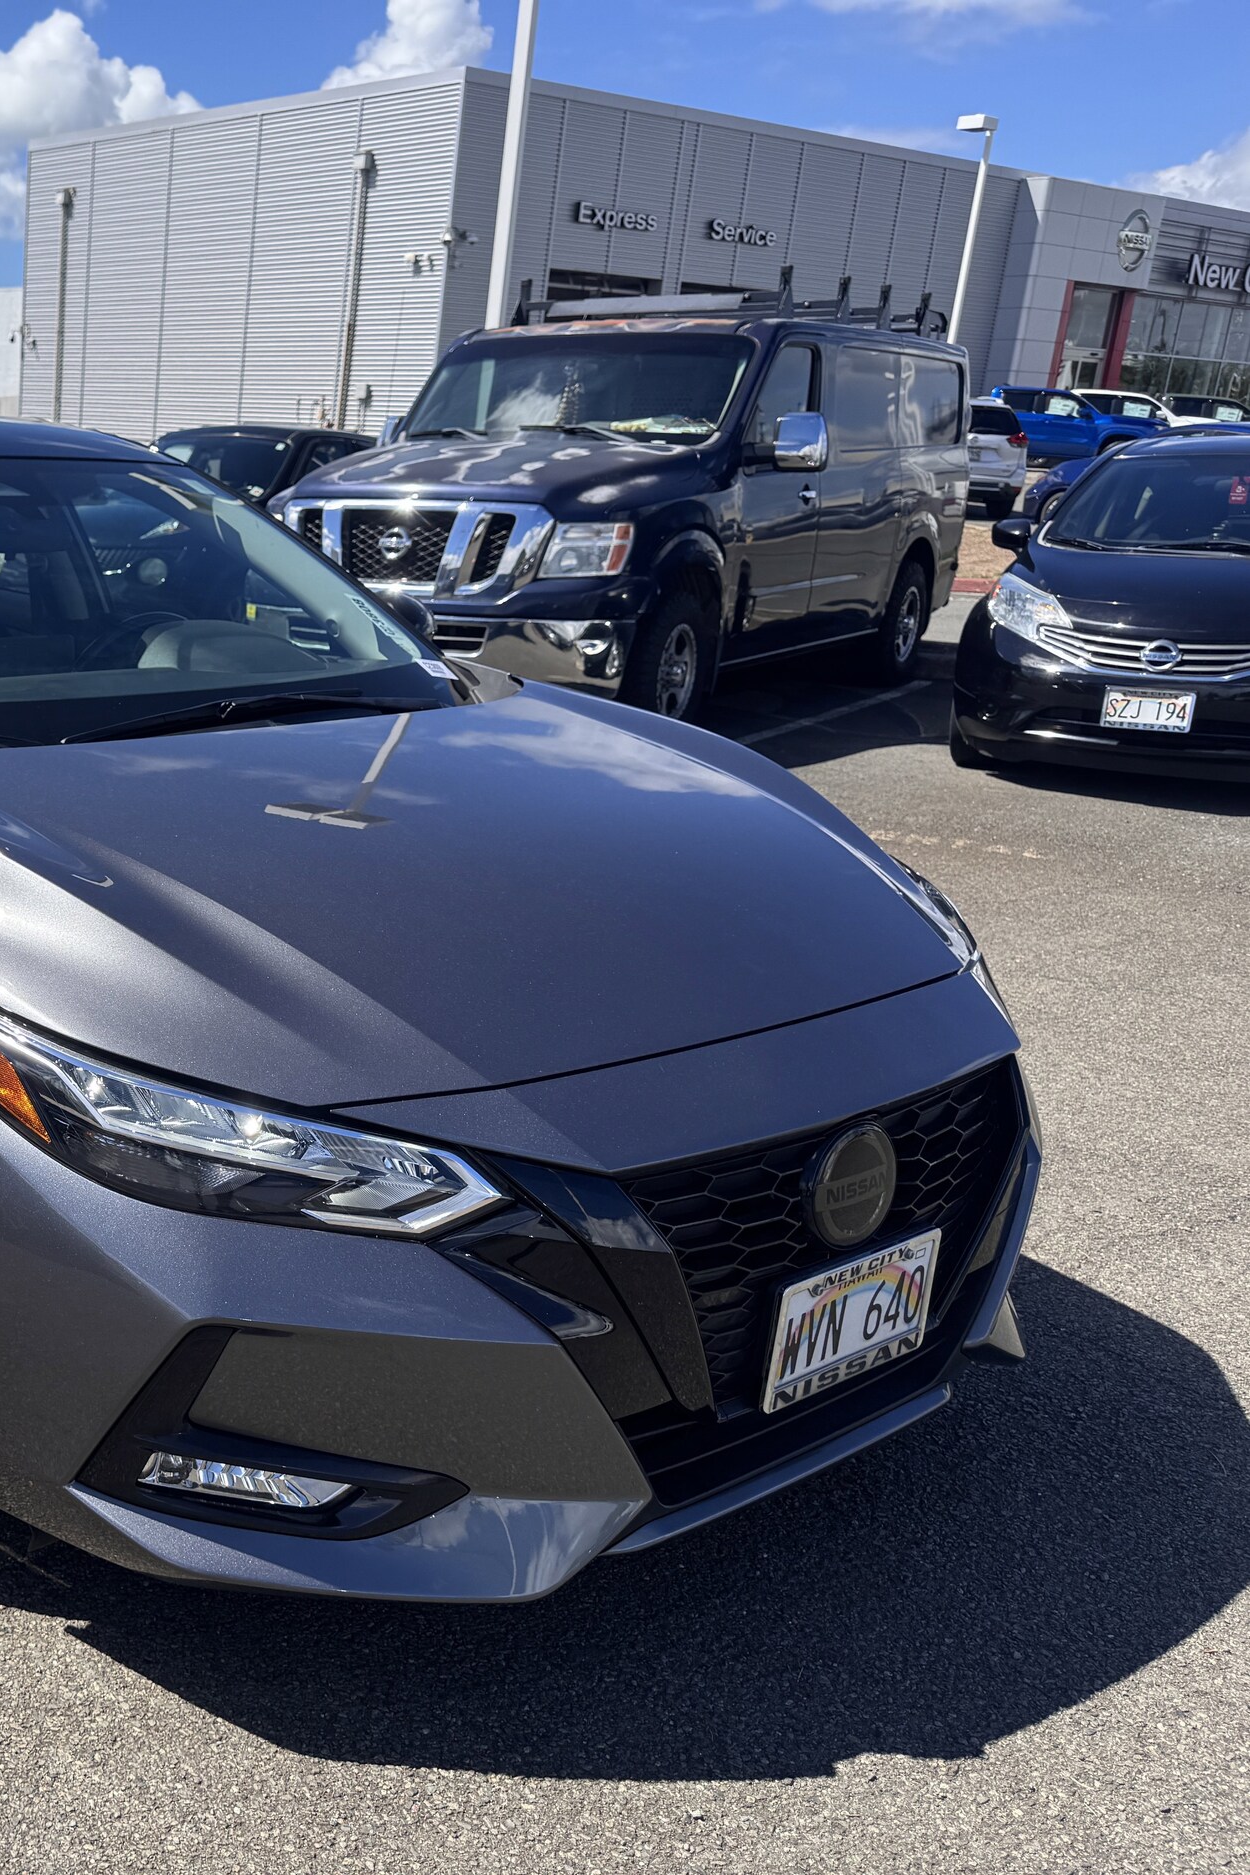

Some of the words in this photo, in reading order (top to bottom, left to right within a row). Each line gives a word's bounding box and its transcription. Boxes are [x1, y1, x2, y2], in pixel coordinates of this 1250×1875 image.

[577, 201, 658, 231] Express
[710, 218, 777, 247] Service
[1188, 253, 1241, 291] New
[1103, 720, 1186, 732] NISSAN
[1106, 698, 1142, 719] SZJ
[1155, 701, 1188, 723] 194
[826, 1171, 887, 1205] NISSAN
[824, 1262, 864, 1289] NEW
[867, 1245, 908, 1271] CITY
[779, 1294, 848, 1380] WVN
[862, 1265, 925, 1341] 640
[772, 1332, 919, 1410] NISSAN
